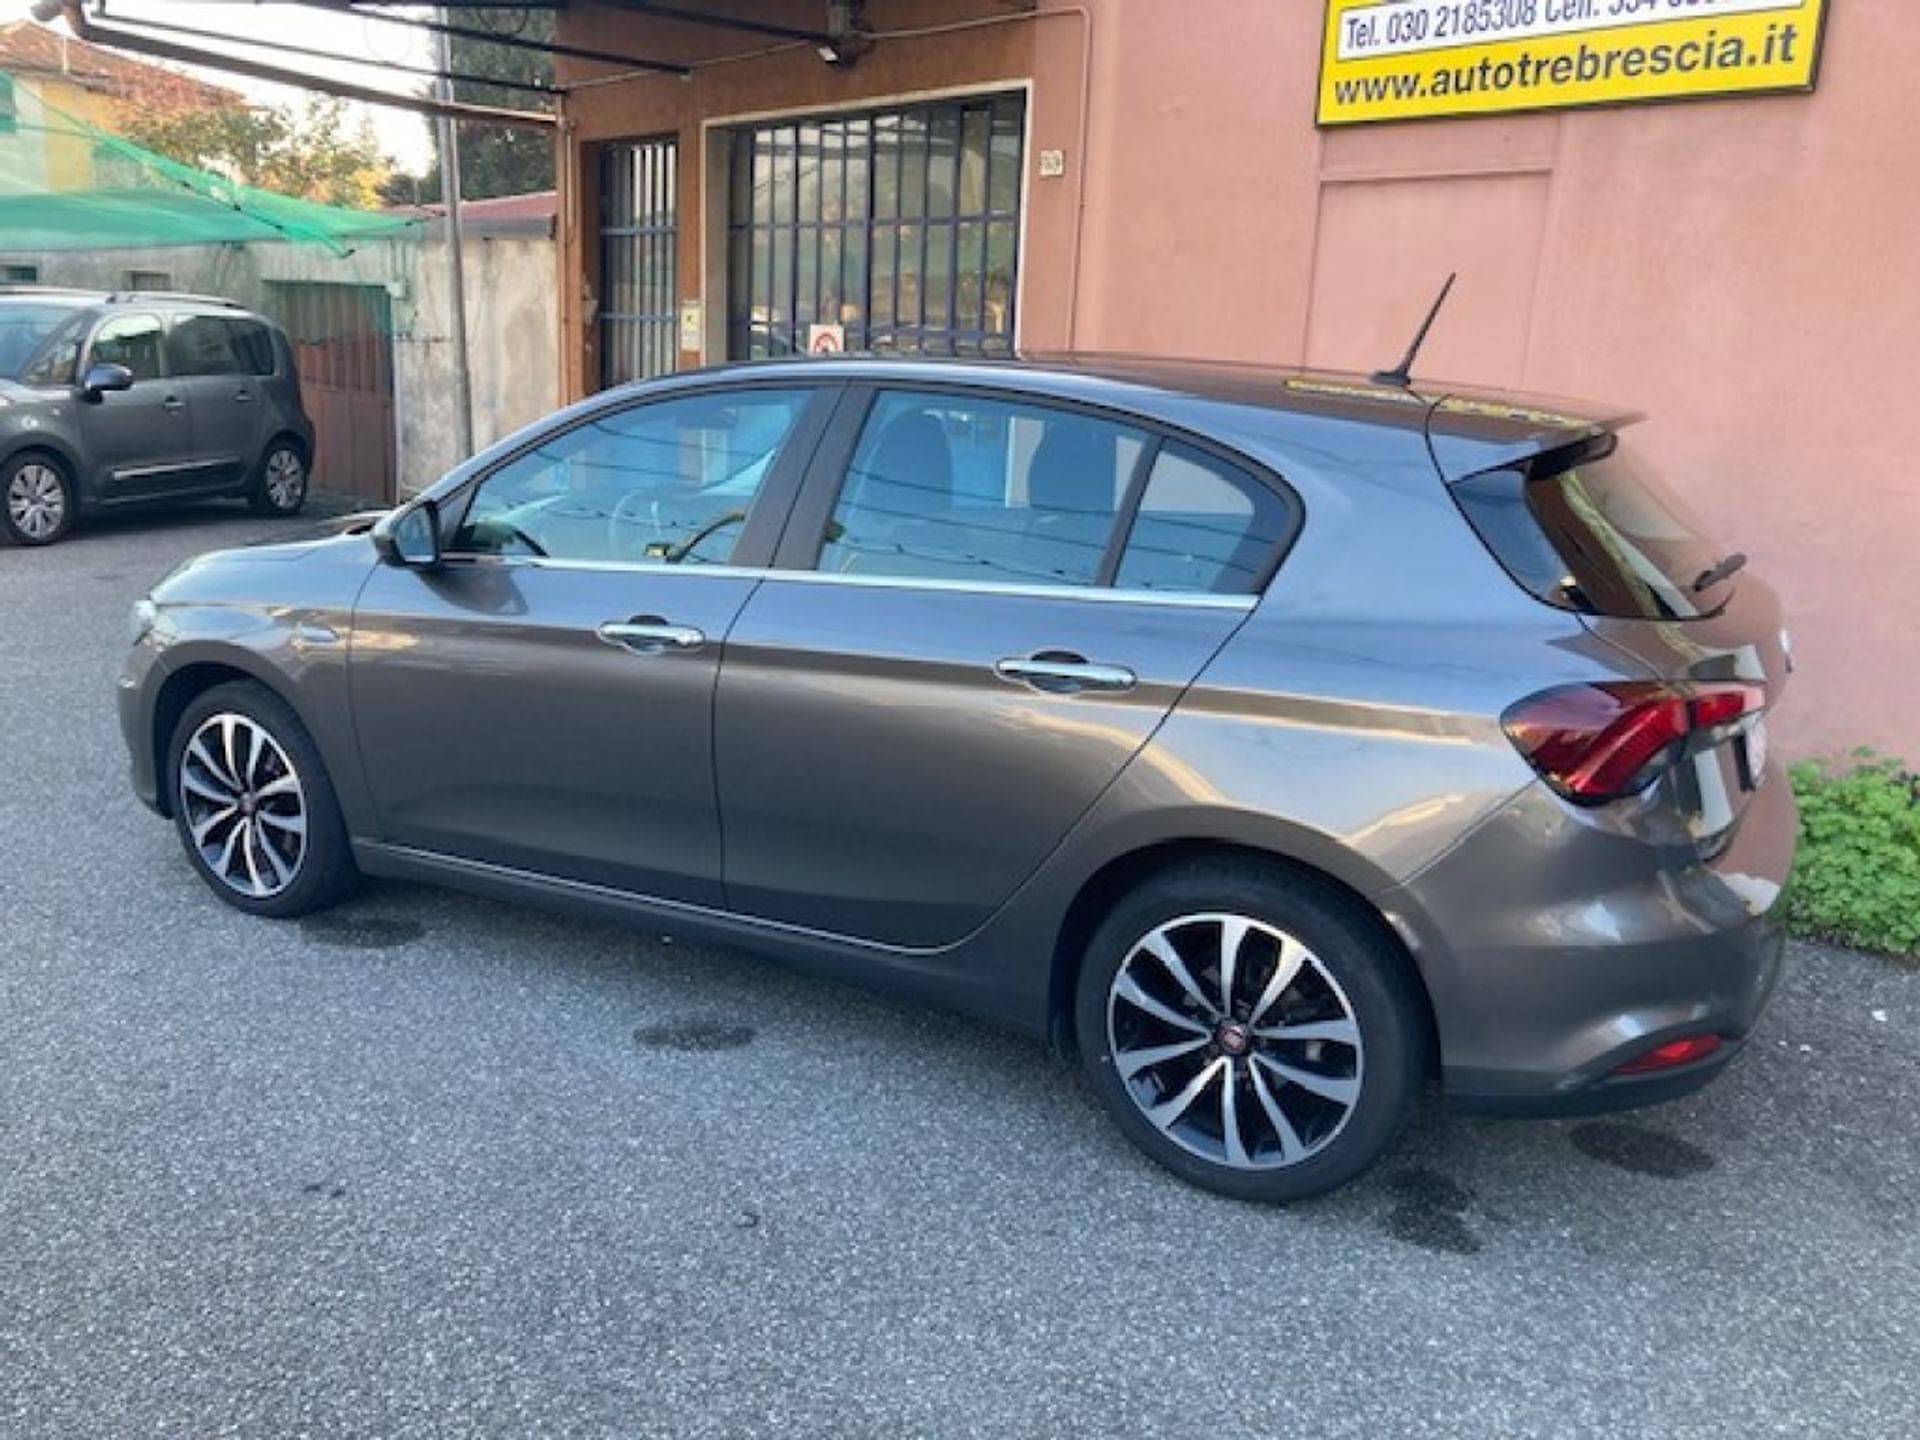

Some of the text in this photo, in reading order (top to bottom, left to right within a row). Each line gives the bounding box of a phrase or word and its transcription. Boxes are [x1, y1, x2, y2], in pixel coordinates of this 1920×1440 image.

[1346, 16, 1381, 48] Tel.
[1386, 9, 1429, 43] 030
[1434, 0, 1537, 37] 2185308
[1335, 23, 1798, 105] www.autotrebrescia.it
